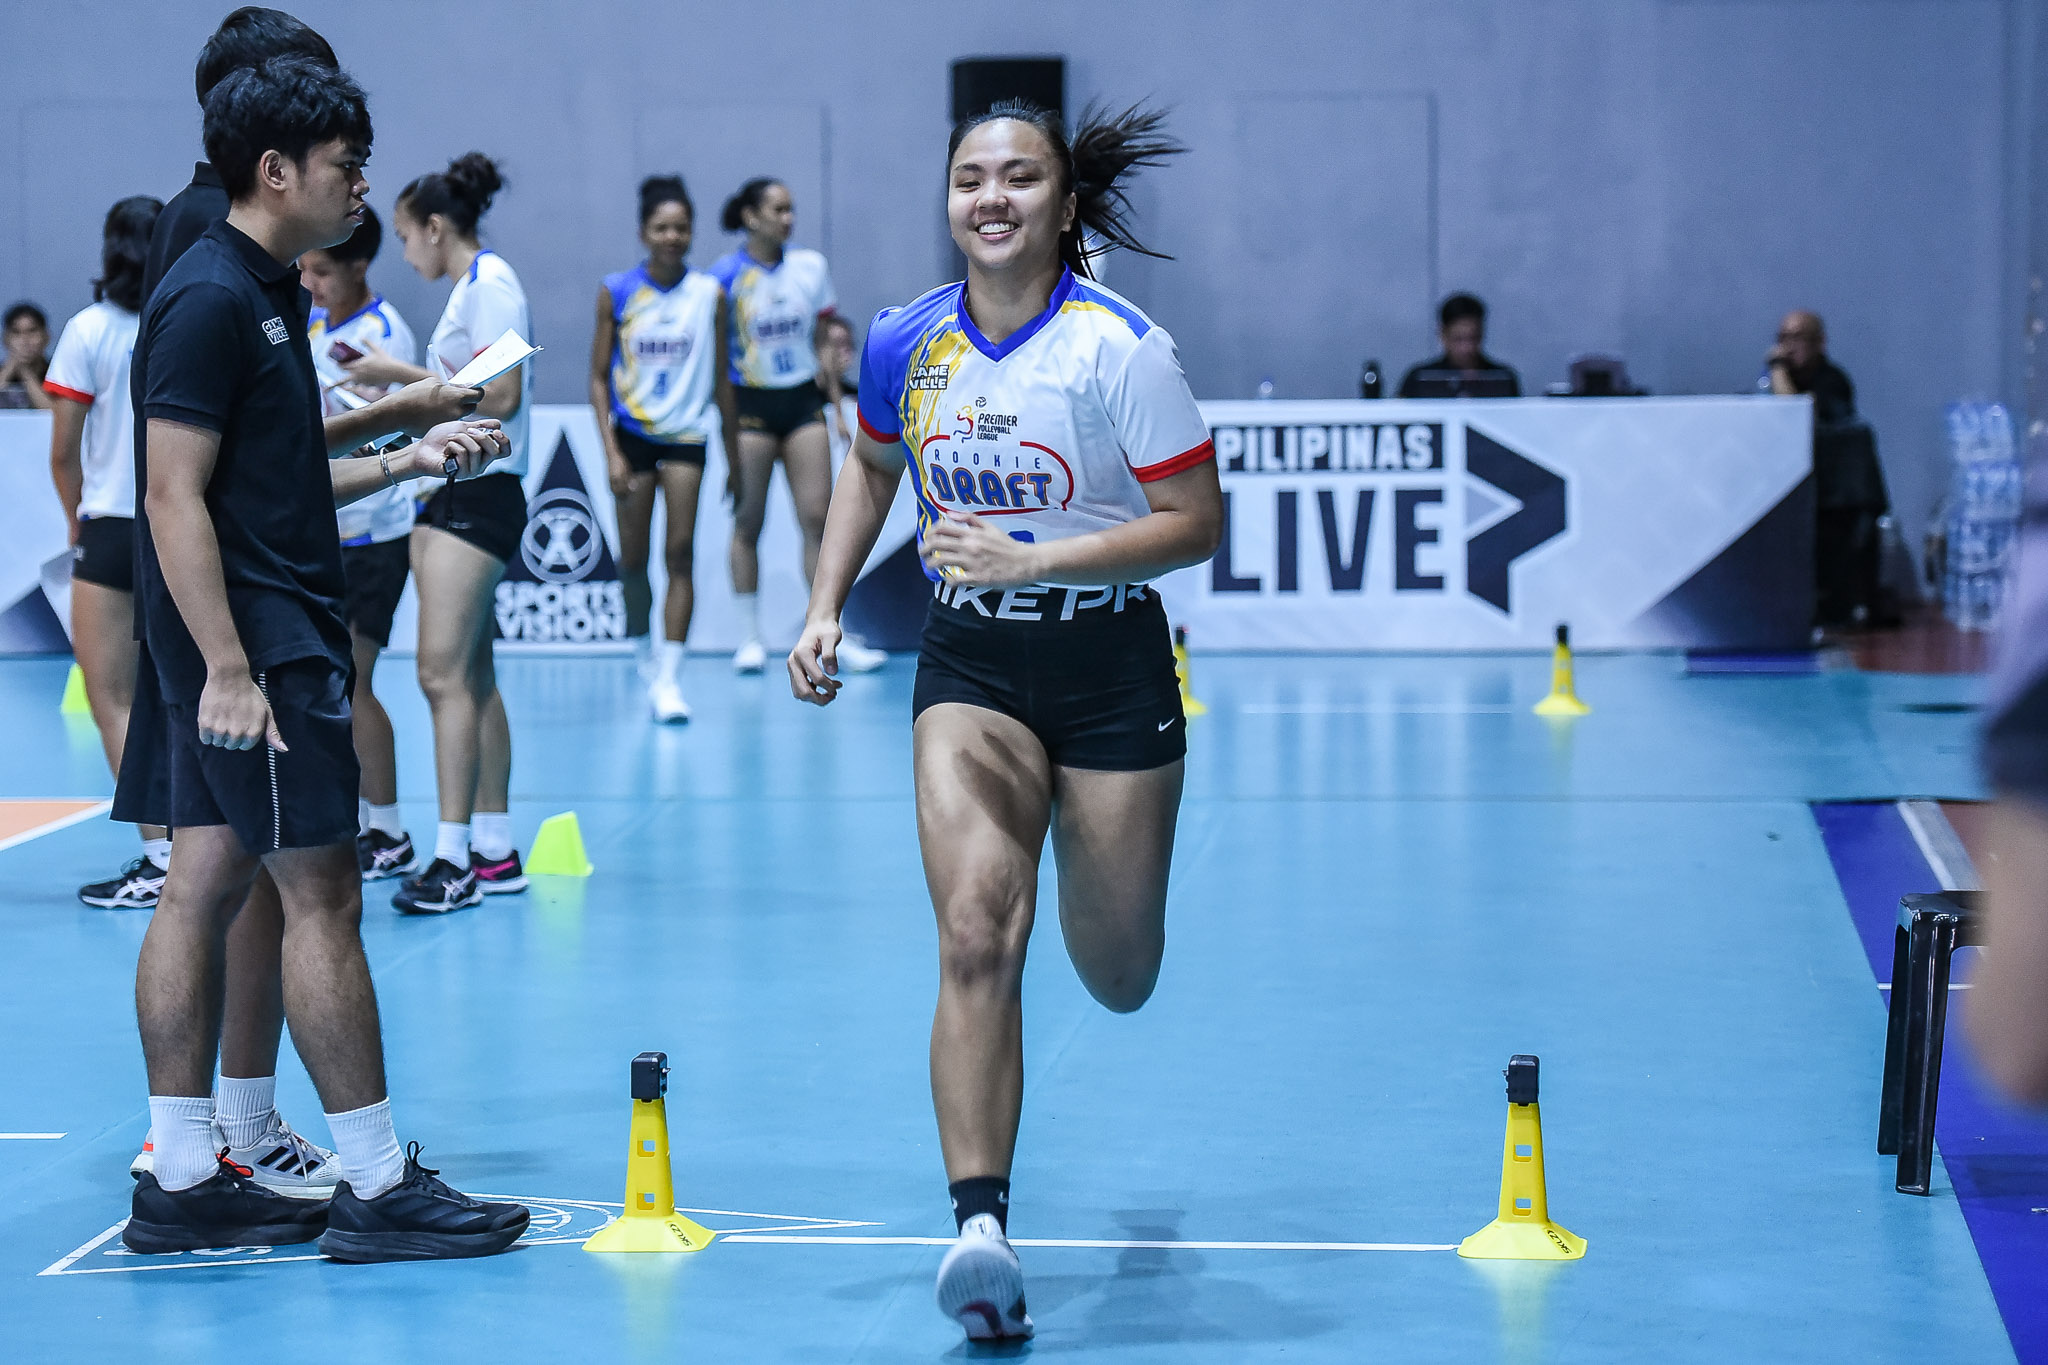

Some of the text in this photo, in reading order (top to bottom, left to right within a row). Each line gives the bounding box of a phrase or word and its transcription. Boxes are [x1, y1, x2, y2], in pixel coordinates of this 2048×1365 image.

[911, 365, 949, 378] AME
[908, 377, 948, 390] VILLE
[977, 424, 1012, 435] VOLLEYBALL
[978, 413, 1018, 427] PREMIER
[977, 432, 999, 441] LEAGUE
[934, 448, 1041, 469] ROOKIE
[1215, 425, 1434, 471] PILIPINAS
[930, 463, 1052, 508] DRAFT
[1213, 489, 1443, 590] LIVE
[494, 580, 625, 615] SPORTS
[495, 613, 627, 642] VISION
